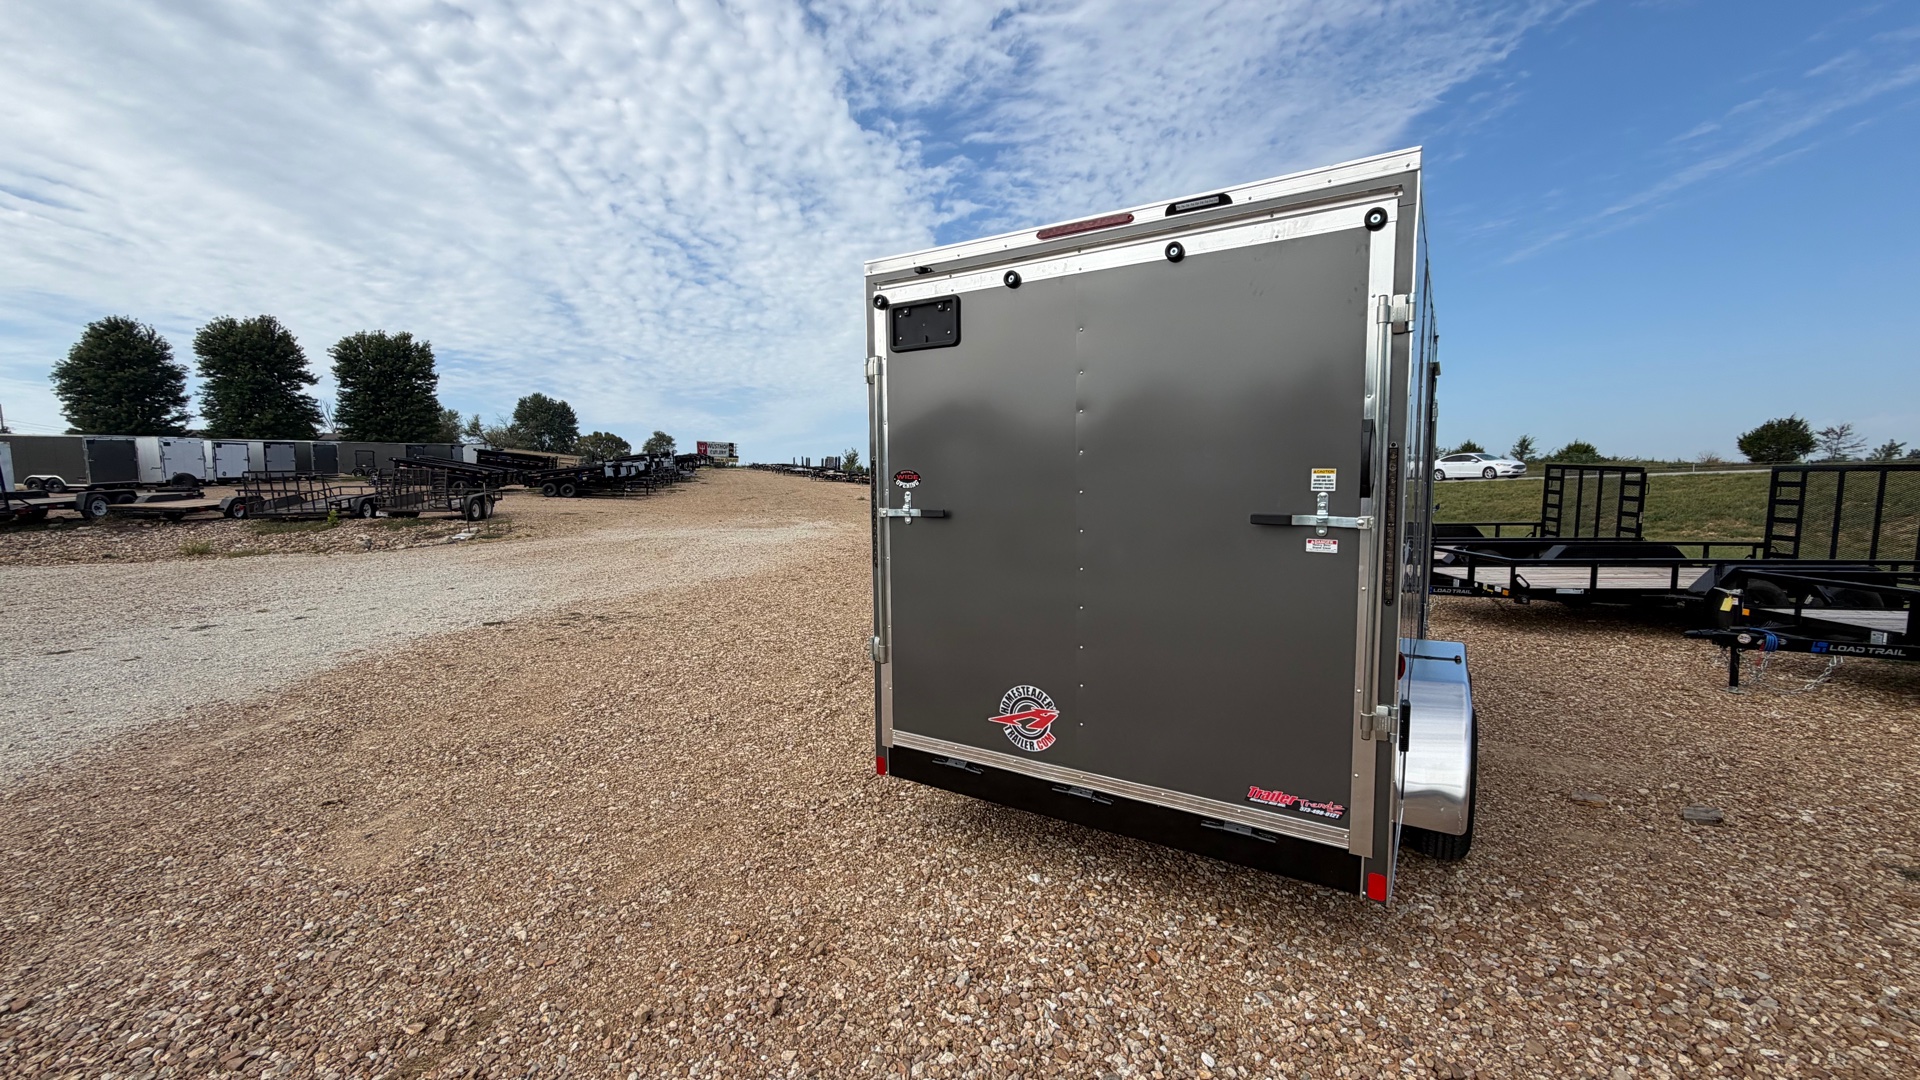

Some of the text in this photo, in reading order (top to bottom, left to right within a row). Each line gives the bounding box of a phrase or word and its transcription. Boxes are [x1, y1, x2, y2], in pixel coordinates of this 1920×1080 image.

[1829, 644, 1866, 654] LOAD
[1867, 647, 1907, 657] TRAIL
[1000, 686, 1054, 715] HOMESTEADER
[1004, 725, 1055, 751] TRAILER.COM
[1247, 786, 1298, 806] Trailer
